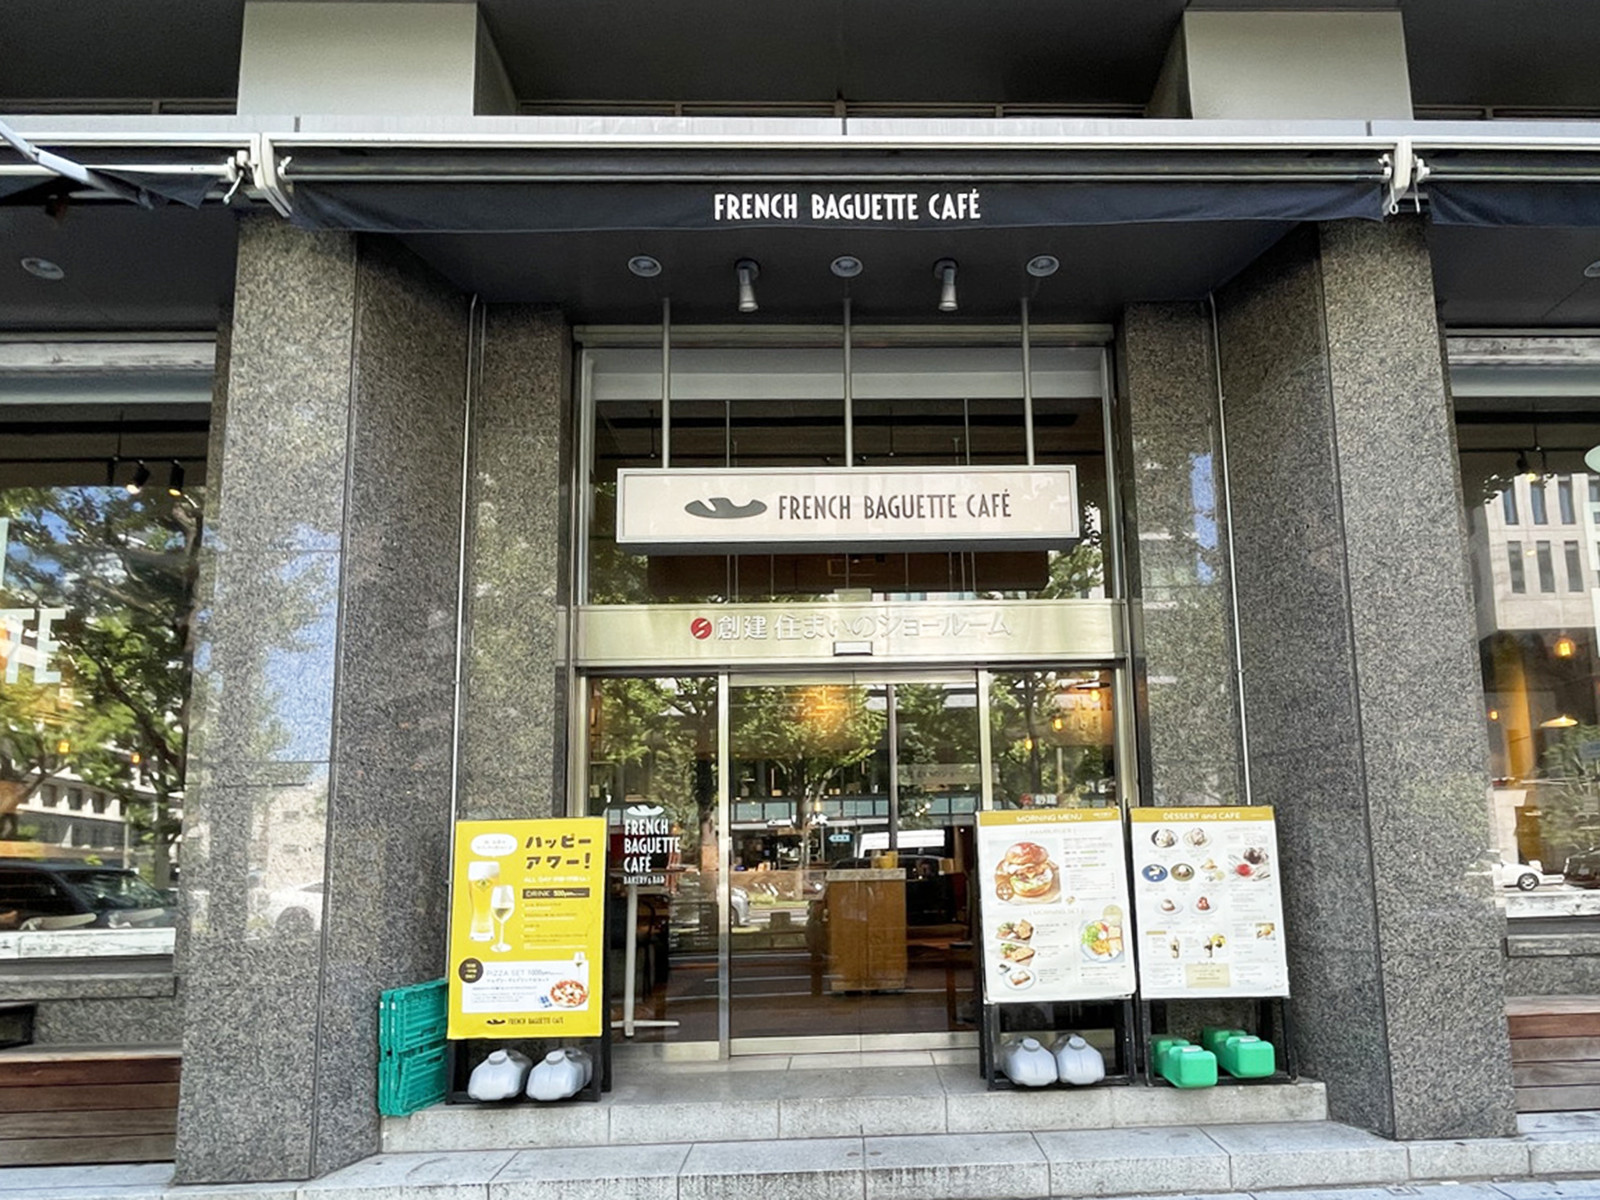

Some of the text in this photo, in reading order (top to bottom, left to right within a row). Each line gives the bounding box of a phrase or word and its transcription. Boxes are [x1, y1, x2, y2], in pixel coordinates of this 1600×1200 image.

[713, 188, 981, 221] FRENCH BAGUETTE CAFÉ
[779, 488, 1012, 520] FRENCH BAGUETTE CAFÉ
[715, 613, 1012, 641] 創建 住まいのショールーム
[1016, 813, 1056, 824] MORNING
[1057, 812, 1082, 821] MENU
[1163, 811, 1200, 821] DESSERT
[624, 818, 669, 836] FRENCH
[525, 833, 592, 849] ハッピー
[623, 836, 681, 854] BAGUETTE
[526, 852, 591, 870] アワー!
[623, 853, 652, 873] CAFÉ
[525, 889, 551, 898] DRINK
[486, 969, 509, 977] PIZZA
